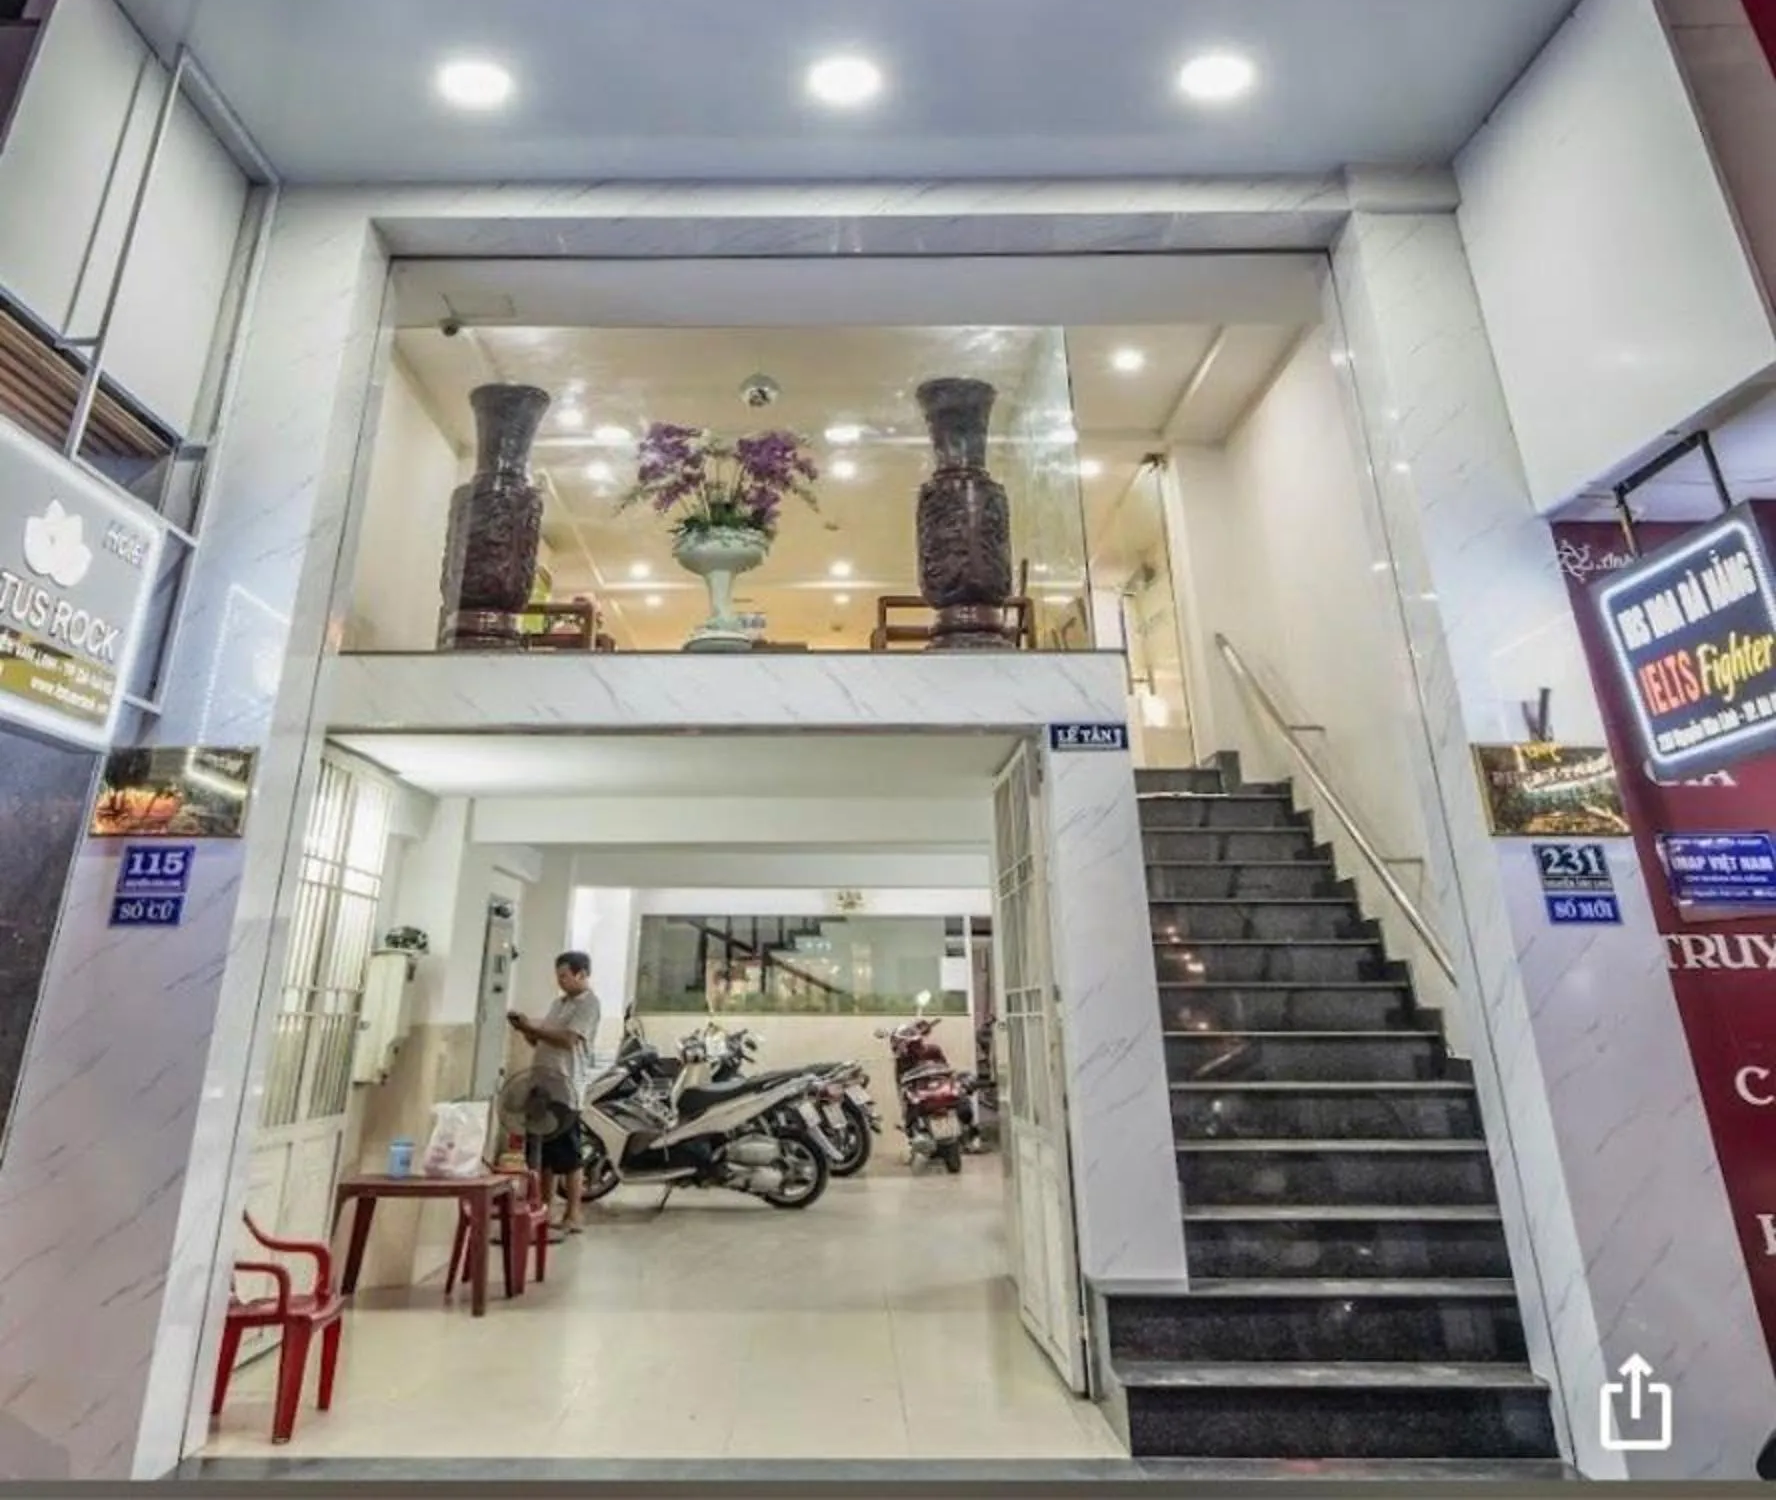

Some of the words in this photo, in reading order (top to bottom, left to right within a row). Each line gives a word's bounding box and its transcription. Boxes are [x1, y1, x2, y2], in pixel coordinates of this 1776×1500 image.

[51, 600, 119, 661] ROCK
[1638, 648, 1701, 717] IELTS
[1695, 629, 1775, 703] Fighter
[127, 852, 185, 876] 115
[1541, 846, 1602, 875] 231
